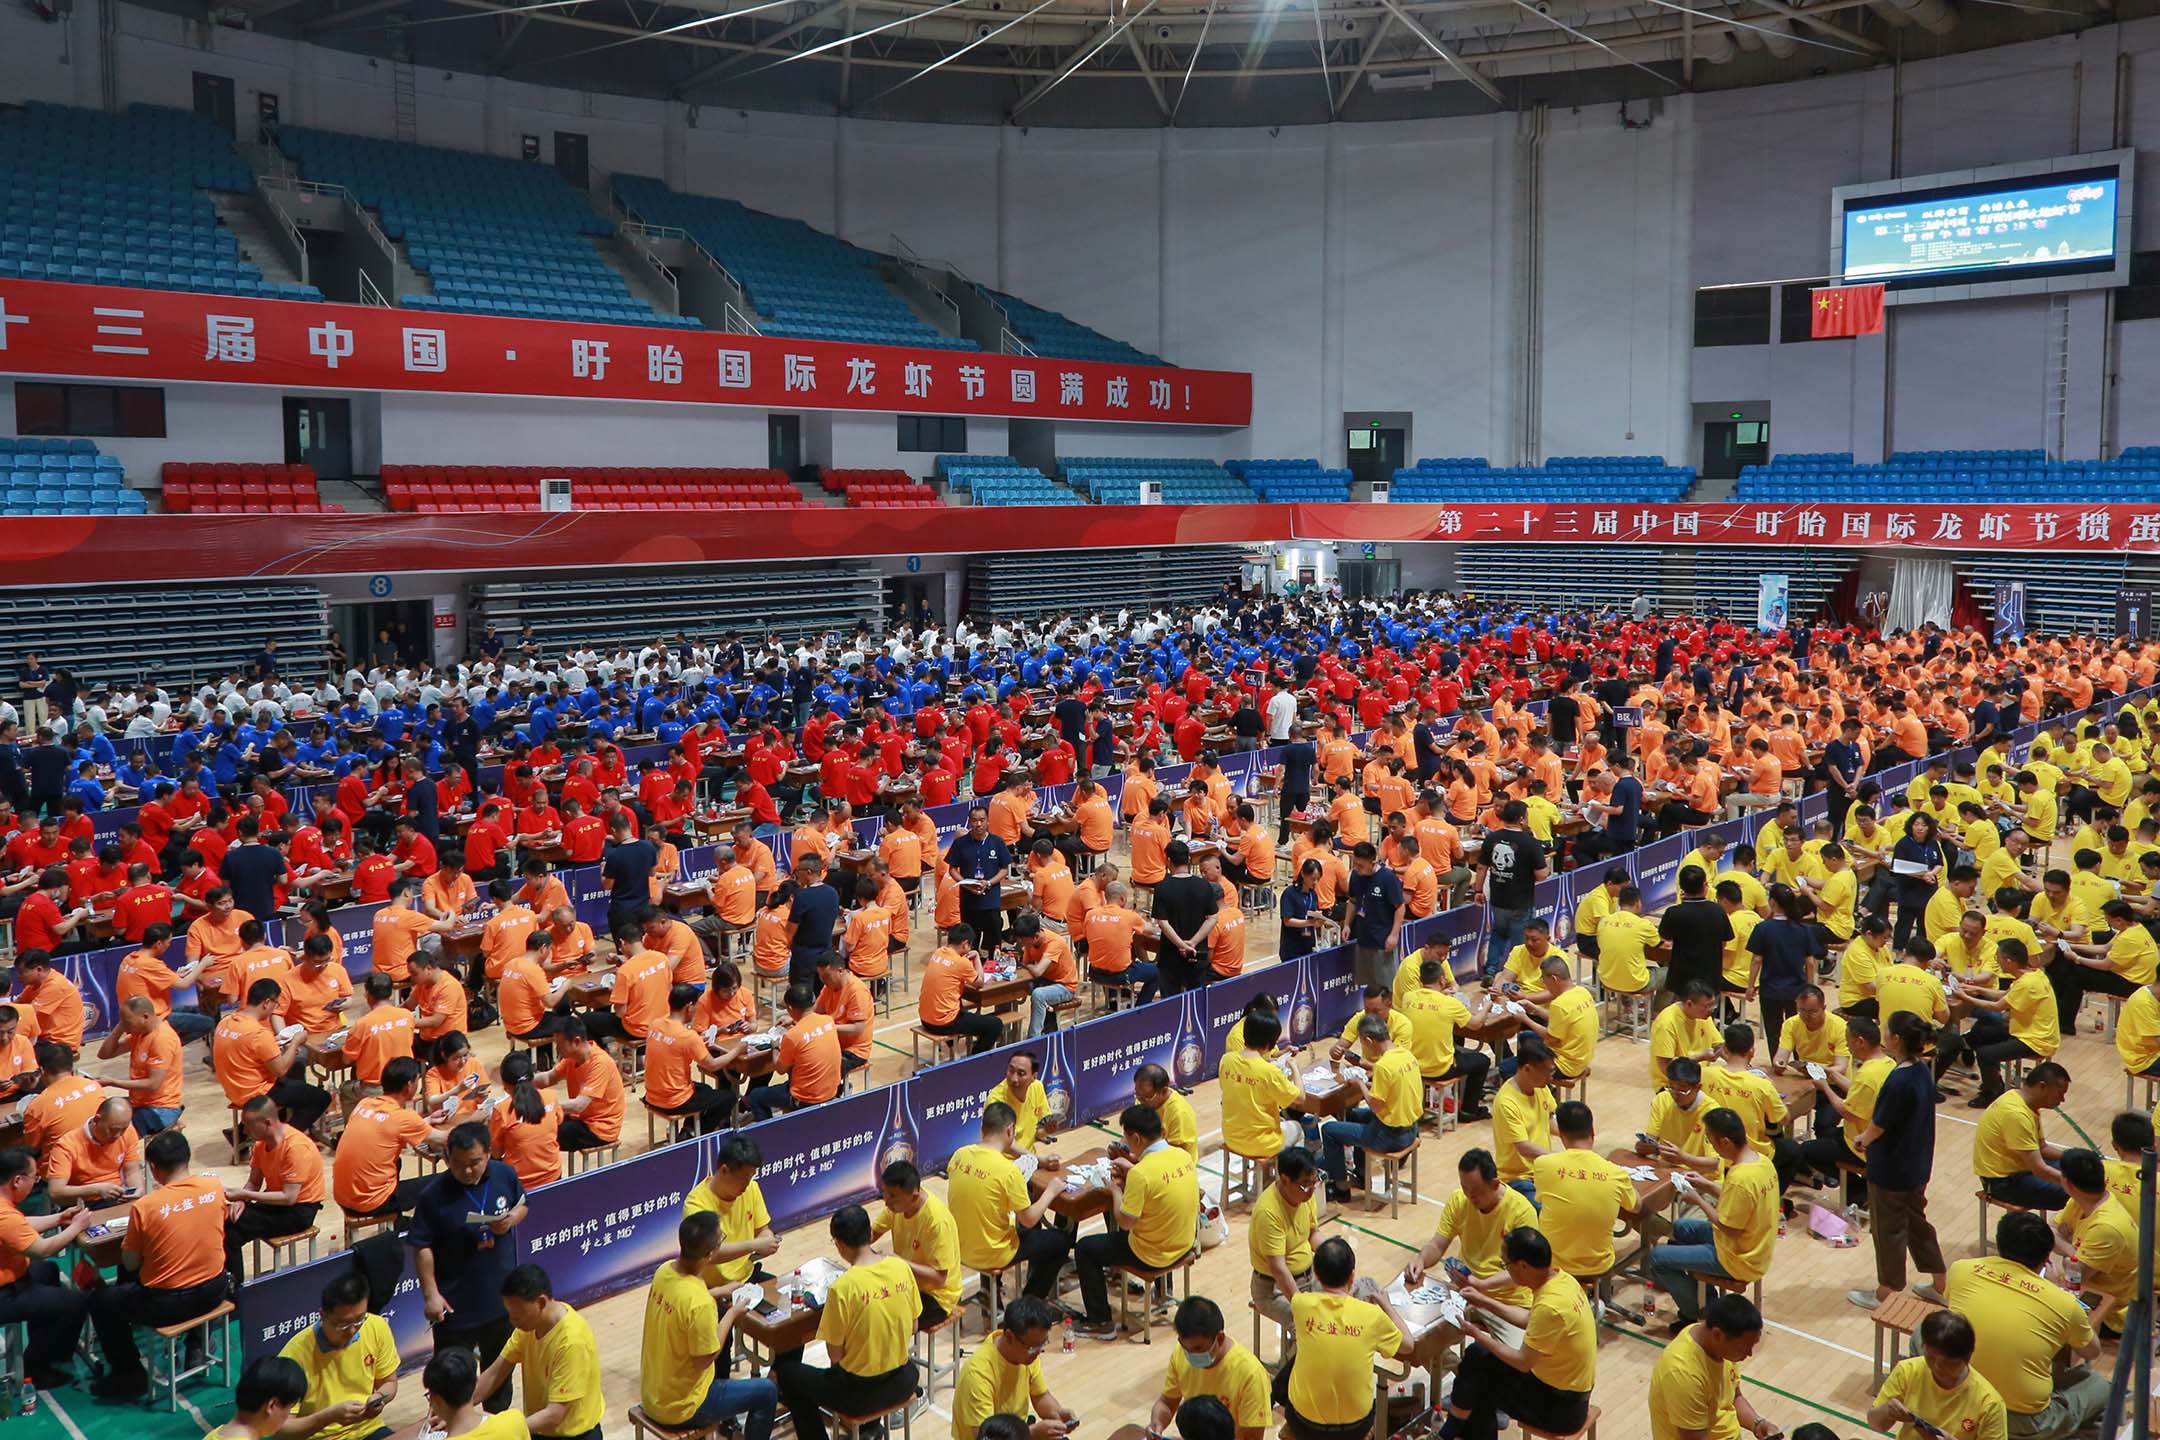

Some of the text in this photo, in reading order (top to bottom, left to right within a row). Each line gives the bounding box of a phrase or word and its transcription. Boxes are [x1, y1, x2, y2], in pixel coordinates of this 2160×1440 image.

[909, 557, 919, 572] 1
[374, 577, 388, 595] 8
[925, 1095, 975, 1120] 更好的时代
[809, 1130, 874, 1161] 值得更好的你
[530, 1191, 682, 1255] 更好的时代 值得更好的你
